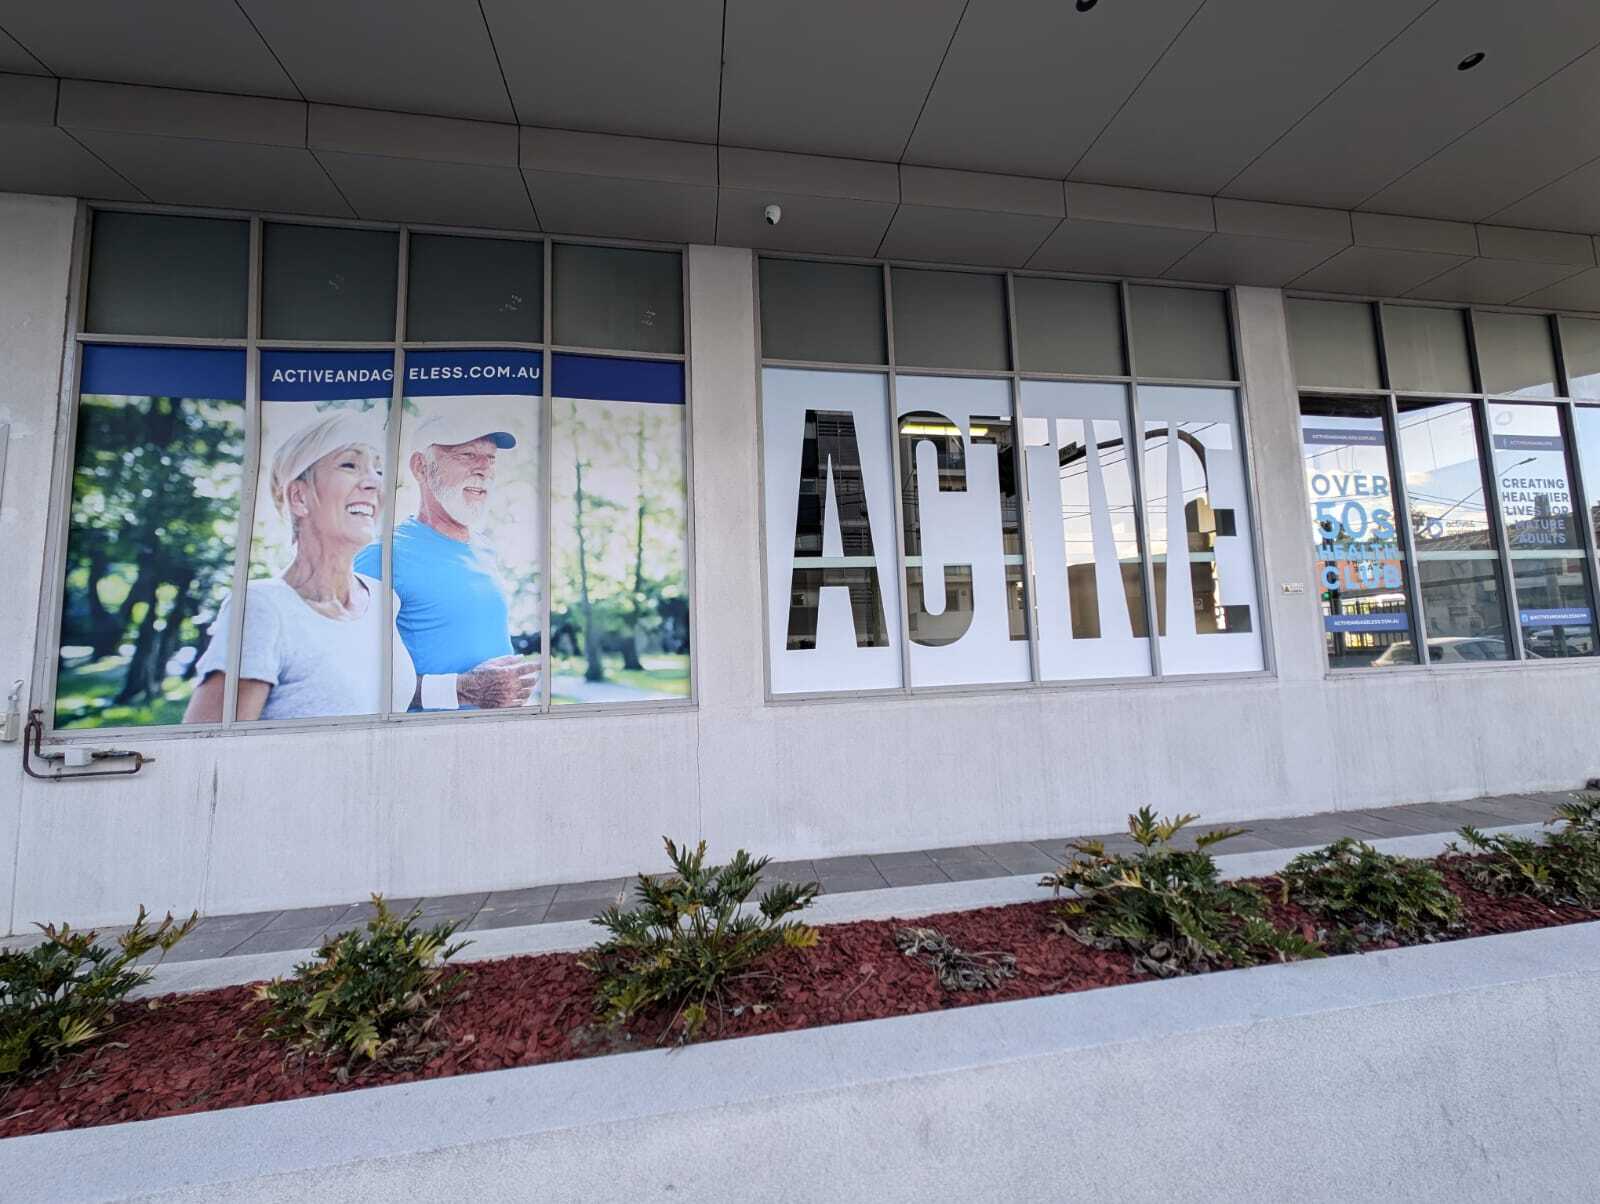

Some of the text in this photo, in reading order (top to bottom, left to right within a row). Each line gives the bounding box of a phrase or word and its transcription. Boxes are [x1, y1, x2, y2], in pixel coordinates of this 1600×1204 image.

[1311, 473, 1390, 497] OVER
[1501, 478, 1565, 489] CREATING
[1504, 505, 1569, 518] LIVES OR
[786, 408, 1253, 651] ACTIVE
[1515, 519, 1566, 530] MATURE
[1518, 532, 1567, 545] ADULTS
[1315, 543, 1401, 560] HEALTH
[1321, 564, 1402, 590] CLUB
